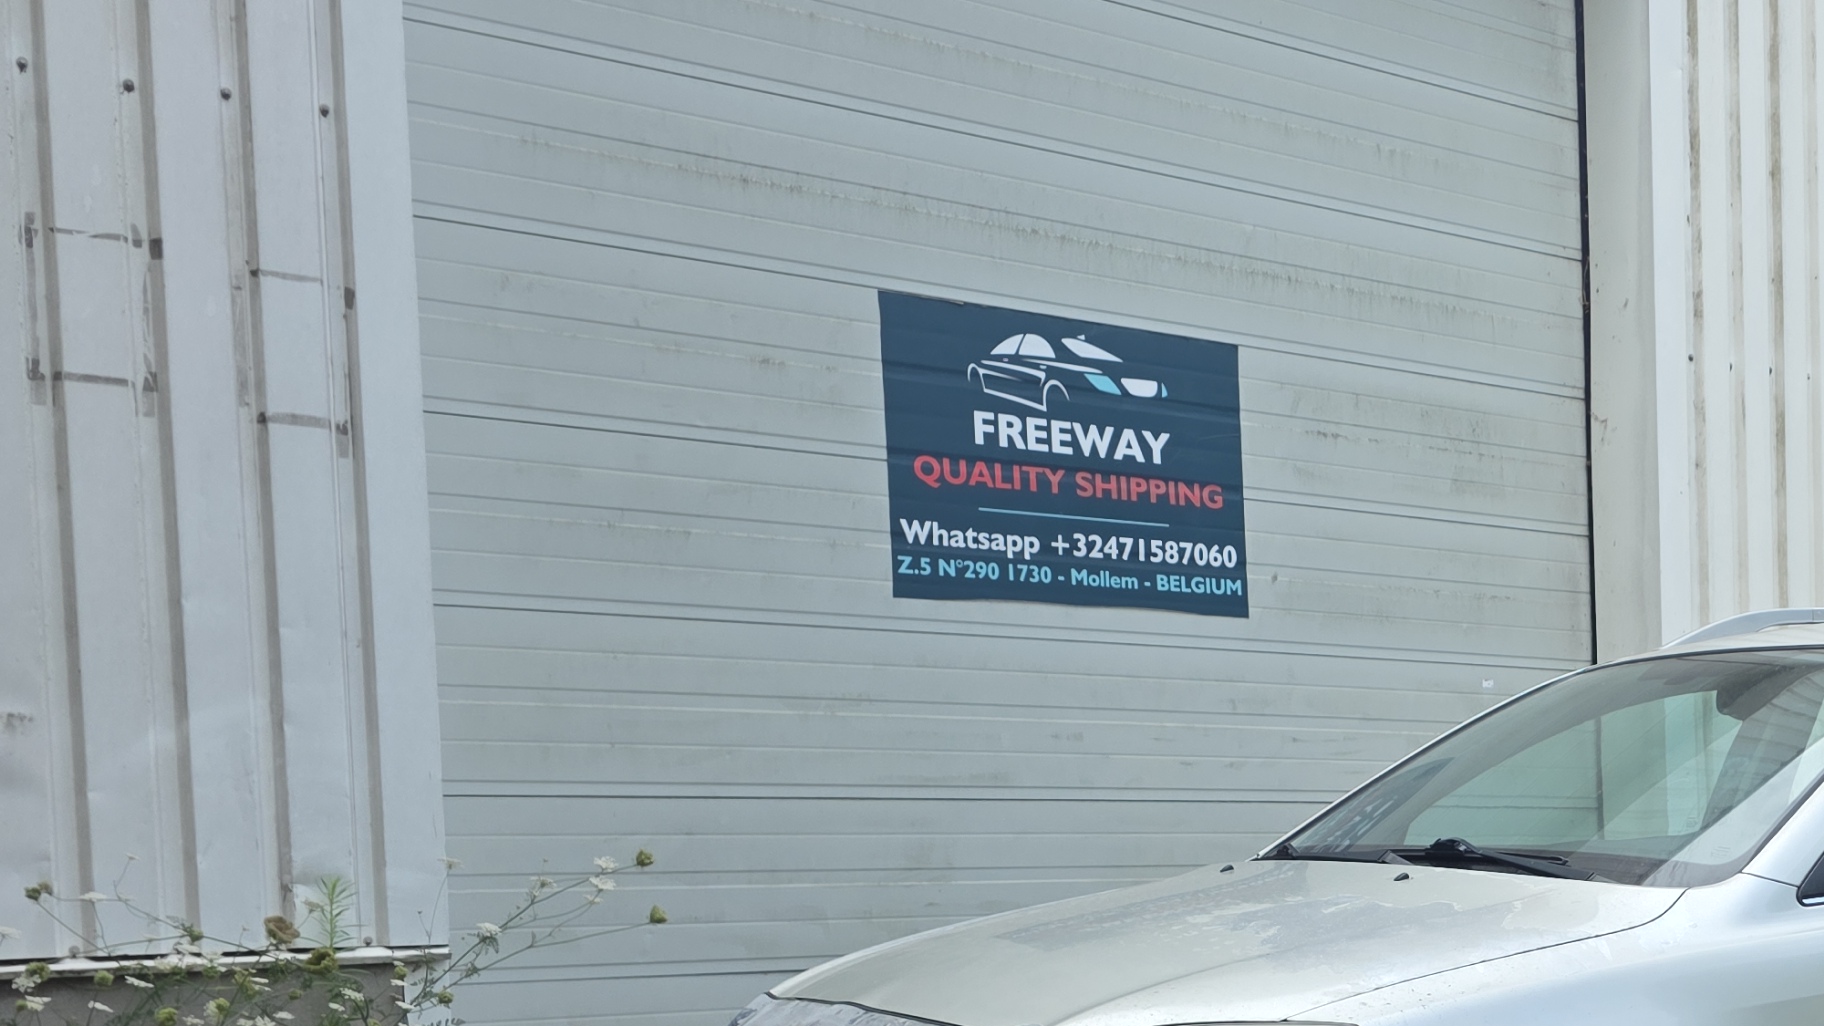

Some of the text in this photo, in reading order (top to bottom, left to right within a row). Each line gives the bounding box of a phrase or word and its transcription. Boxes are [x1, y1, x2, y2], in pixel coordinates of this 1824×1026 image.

[974, 410, 1170, 464] FREEWAY
[914, 455, 1223, 509] QUALITY SHIPPING
[900, 518, 1237, 568] Whatsapp +32471587060
[897, 555, 931, 576] Z.5
[938, 558, 999, 580] N°290
[1008, 563, 1051, 584] 1730
[1071, 567, 1139, 589] Mollem
[1156, 574, 1242, 596] BELGIUM
